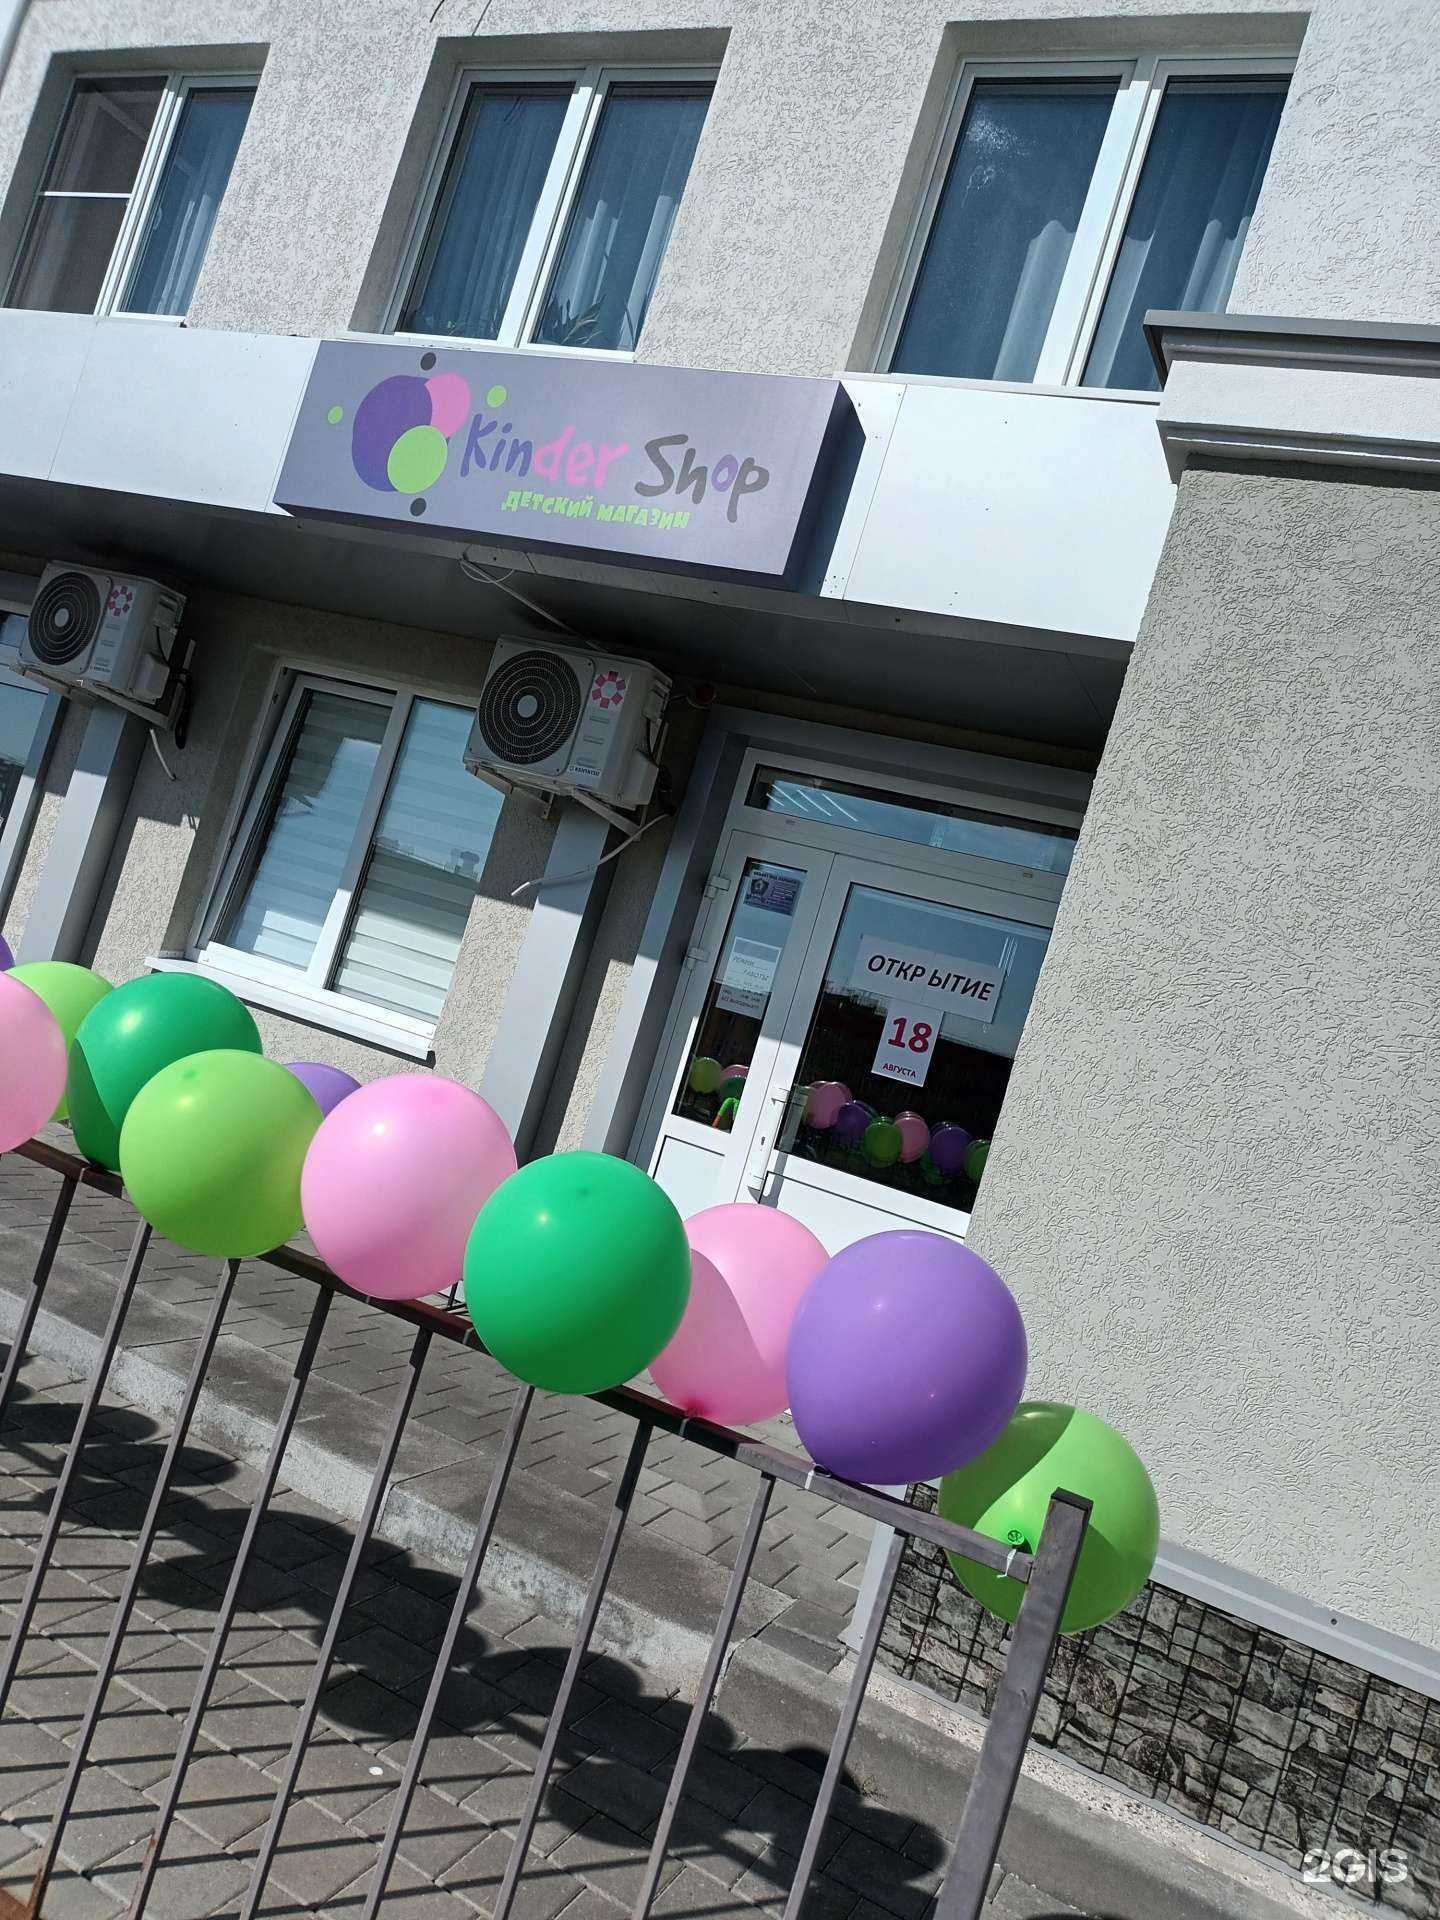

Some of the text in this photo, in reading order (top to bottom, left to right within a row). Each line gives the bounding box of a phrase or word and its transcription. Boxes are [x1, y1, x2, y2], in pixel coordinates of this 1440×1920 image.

[460, 413, 770, 524] Kinder Shop
[501, 490, 690, 530] ДЕТСКИЙ МАГАЗИН
[887, 1017, 932, 1053] 18
[882, 1062, 917, 1078] АВГУСТА
